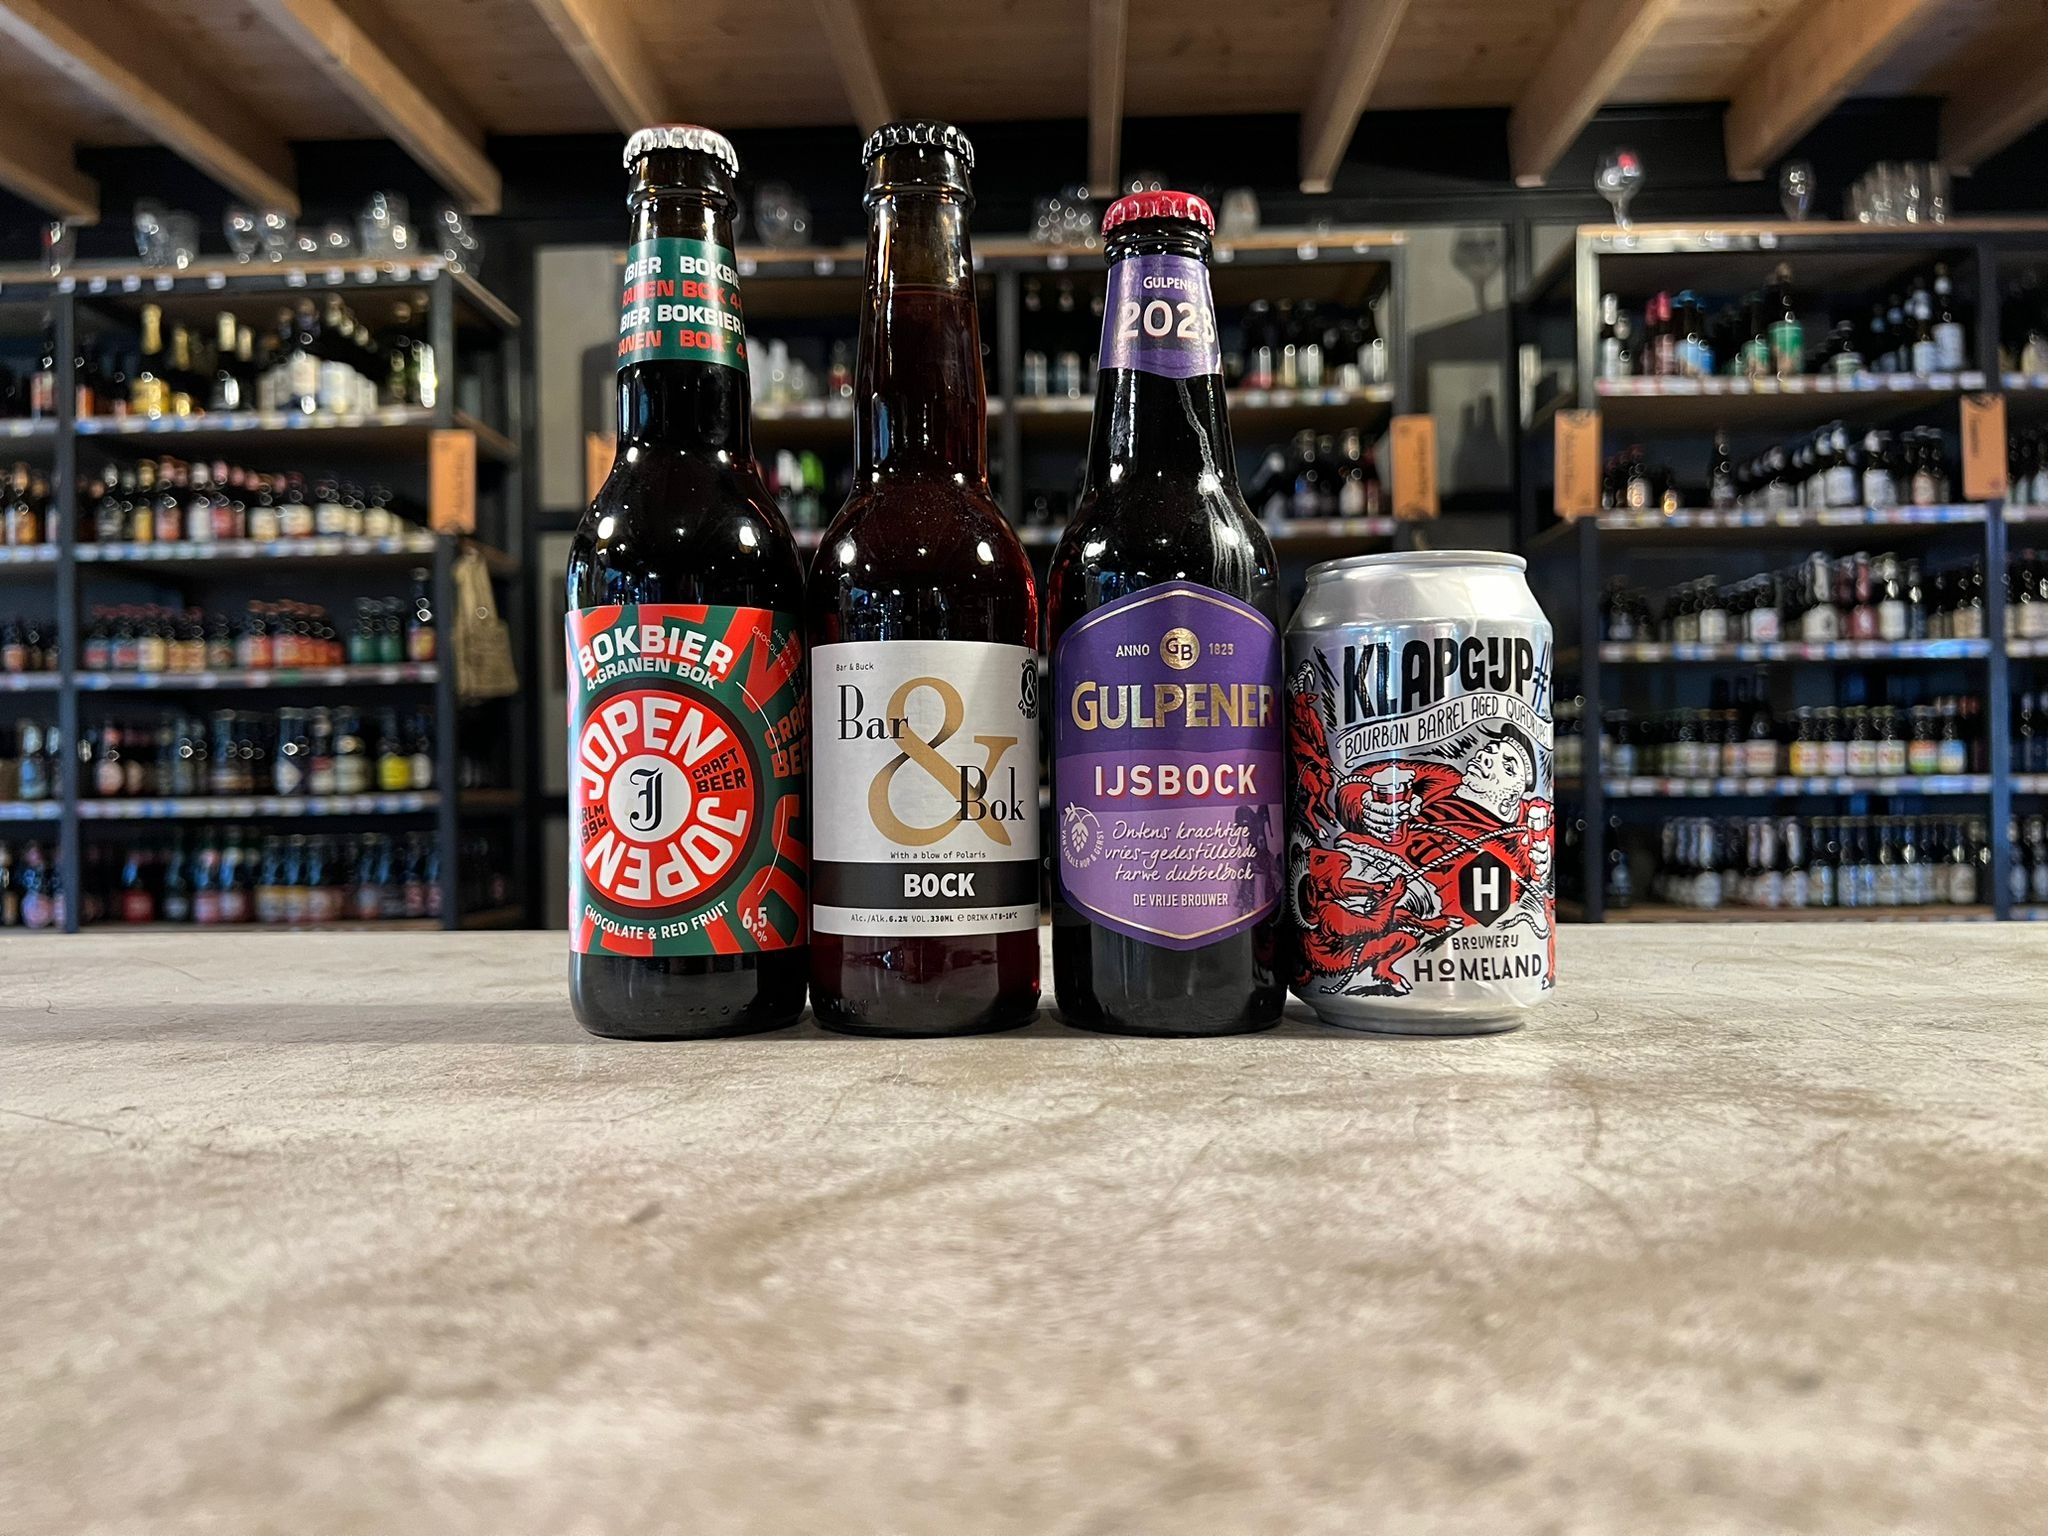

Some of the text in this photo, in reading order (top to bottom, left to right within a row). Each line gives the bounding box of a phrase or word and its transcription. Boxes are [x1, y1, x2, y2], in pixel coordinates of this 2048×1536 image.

[683, 281, 726, 304] BOK
[658, 304, 742, 335] BOKBIER
[680, 330, 725, 352] BOK
[577, 624, 734, 678] BOKBIER
[752, 626, 786, 668] CHOCOLATE
[1115, 644, 1150, 657] ANNO
[587, 657, 720, 691] 4-GRANEN BOK
[855, 661, 874, 671] Buck
[1071, 681, 1274, 731] GULPENER
[1345, 722, 1409, 759] BOURBON
[1418, 701, 1468, 742] BARREL
[1471, 696, 1499, 719] AGED
[578, 697, 728, 800] JOPEN
[692, 747, 740, 780] CRAFT
[837, 684, 908, 740] Bar
[956, 765, 1025, 821] Bok
[696, 767, 747, 793] BEER
[1095, 763, 1257, 797] IJSBOCK
[585, 797, 747, 900] JOPEN
[1176, 820, 1250, 847] krachtige
[890, 851, 909, 859] With
[921, 850, 940, 859] blow
[943, 850, 953, 859] of
[956, 850, 986, 859] Polaris
[904, 872, 975, 897] BOCK
[1115, 862, 1254, 881] tarwe dubbelbock
[1133, 893, 1228, 906] DE VRIJE BROUWER
[1473, 867, 1499, 911] H
[585, 900, 729, 939] CHOCOLATE & RED FRUIT
[967, 913, 988, 921] DRINK
[1452, 934, 1519, 950] BROUWERIJ
[1414, 953, 1542, 982] HOMELAND
